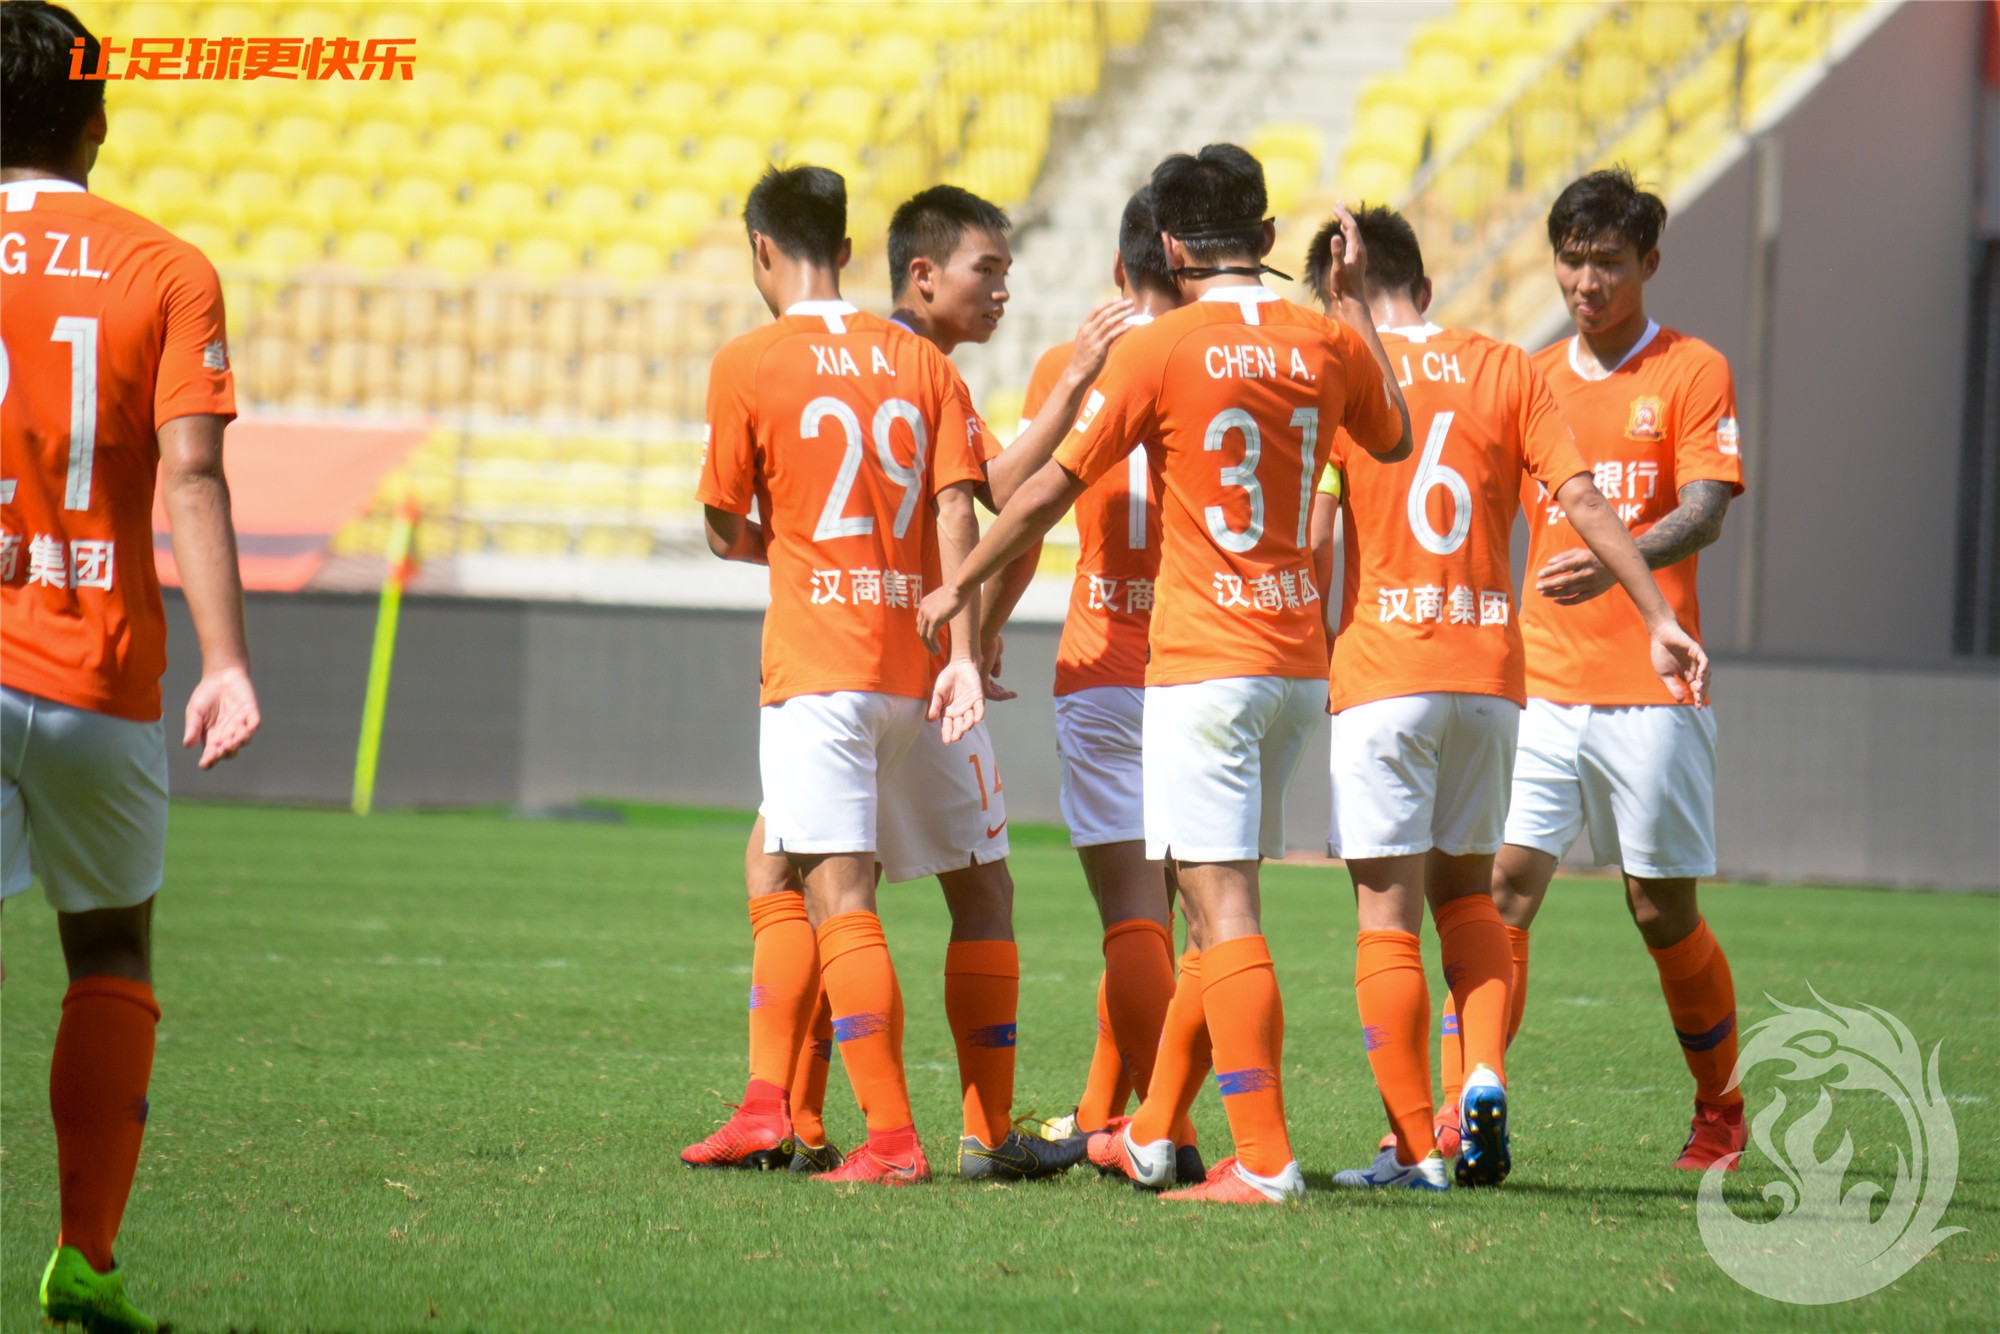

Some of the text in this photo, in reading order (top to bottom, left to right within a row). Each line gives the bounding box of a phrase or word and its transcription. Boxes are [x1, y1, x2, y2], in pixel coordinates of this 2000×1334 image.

[44, 231, 110, 279] Z.L.
[810, 344, 896, 377] XIA A.
[1205, 345, 1317, 381] CHEN A.
[1422, 351, 1466, 384] CH.
[0, 315, 98, 512] 1
[800, 396, 927, 543] 29
[1203, 406, 1319, 554] 31
[1407, 411, 1472, 555] 6
[1212, 568, 1321, 611] 汉商集团
[1377, 583, 1509, 628] 汉商集团
